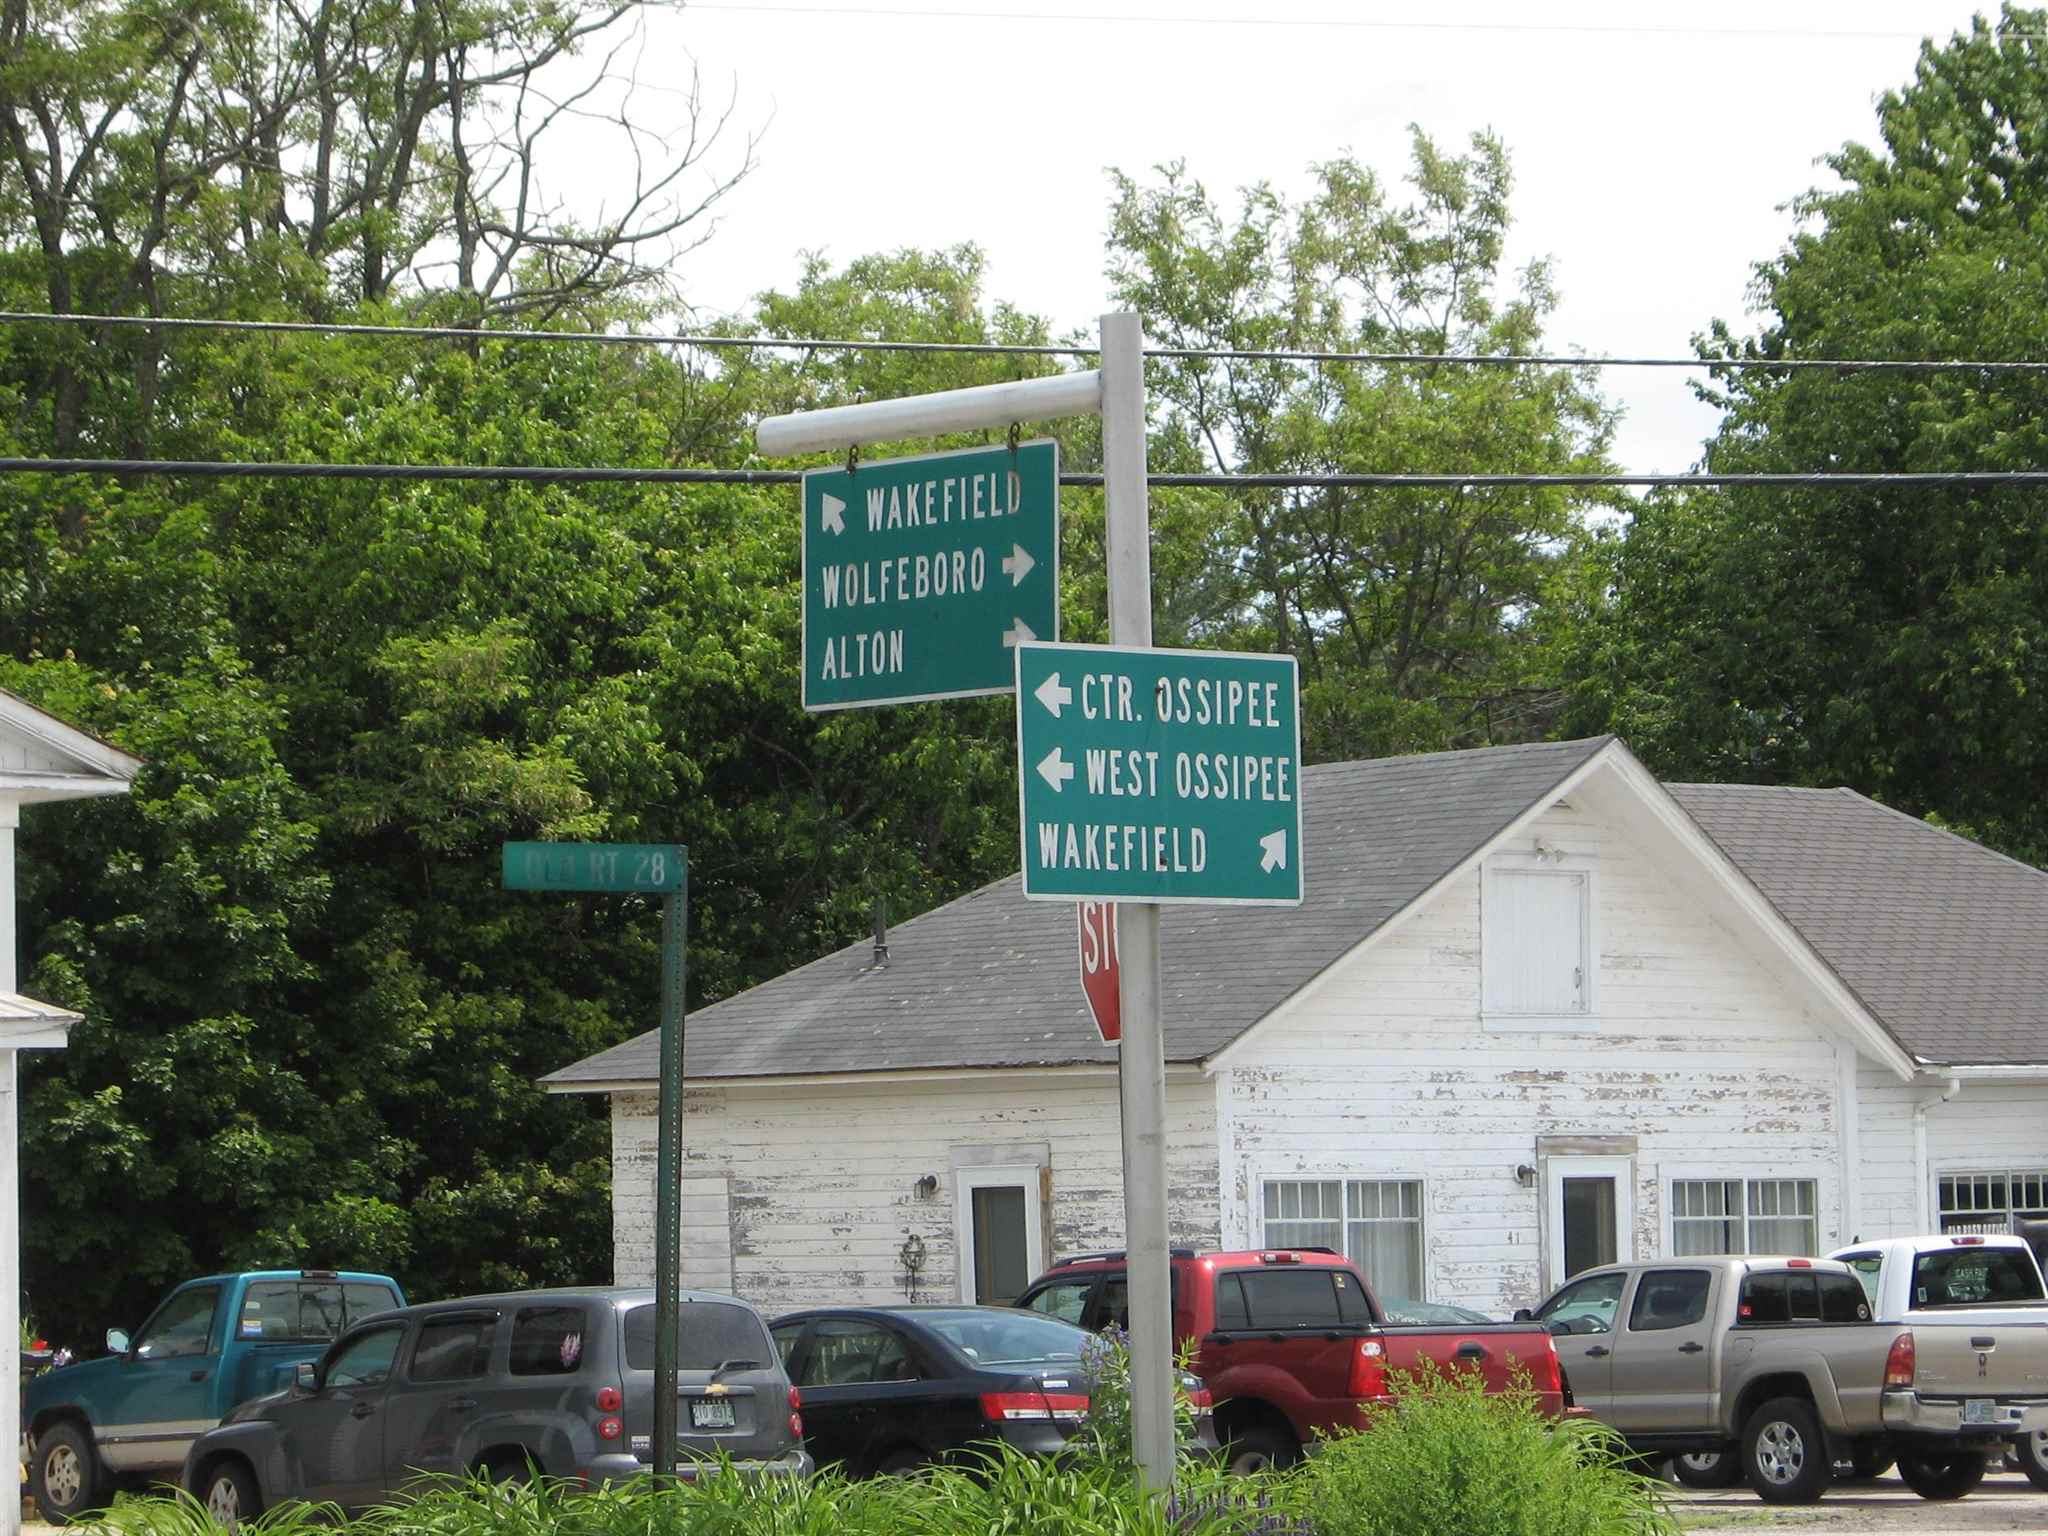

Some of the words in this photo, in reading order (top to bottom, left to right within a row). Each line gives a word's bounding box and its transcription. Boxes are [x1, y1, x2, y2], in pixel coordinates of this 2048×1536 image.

[866, 471, 1022, 532] WAKEFIELD
[822, 546, 986, 609] WOLFEBORO
[822, 629, 904, 681] ALTON
[1081, 673, 1143, 721] CTR.
[1156, 676, 1280, 727] OSSIPEE
[1086, 749, 1159, 797] WEST
[1175, 752, 1291, 801] OSSIPEE
[589, 850, 620, 883] RT
[633, 850, 666, 886] 28
[1038, 822, 1207, 873] WAKEFIELD
